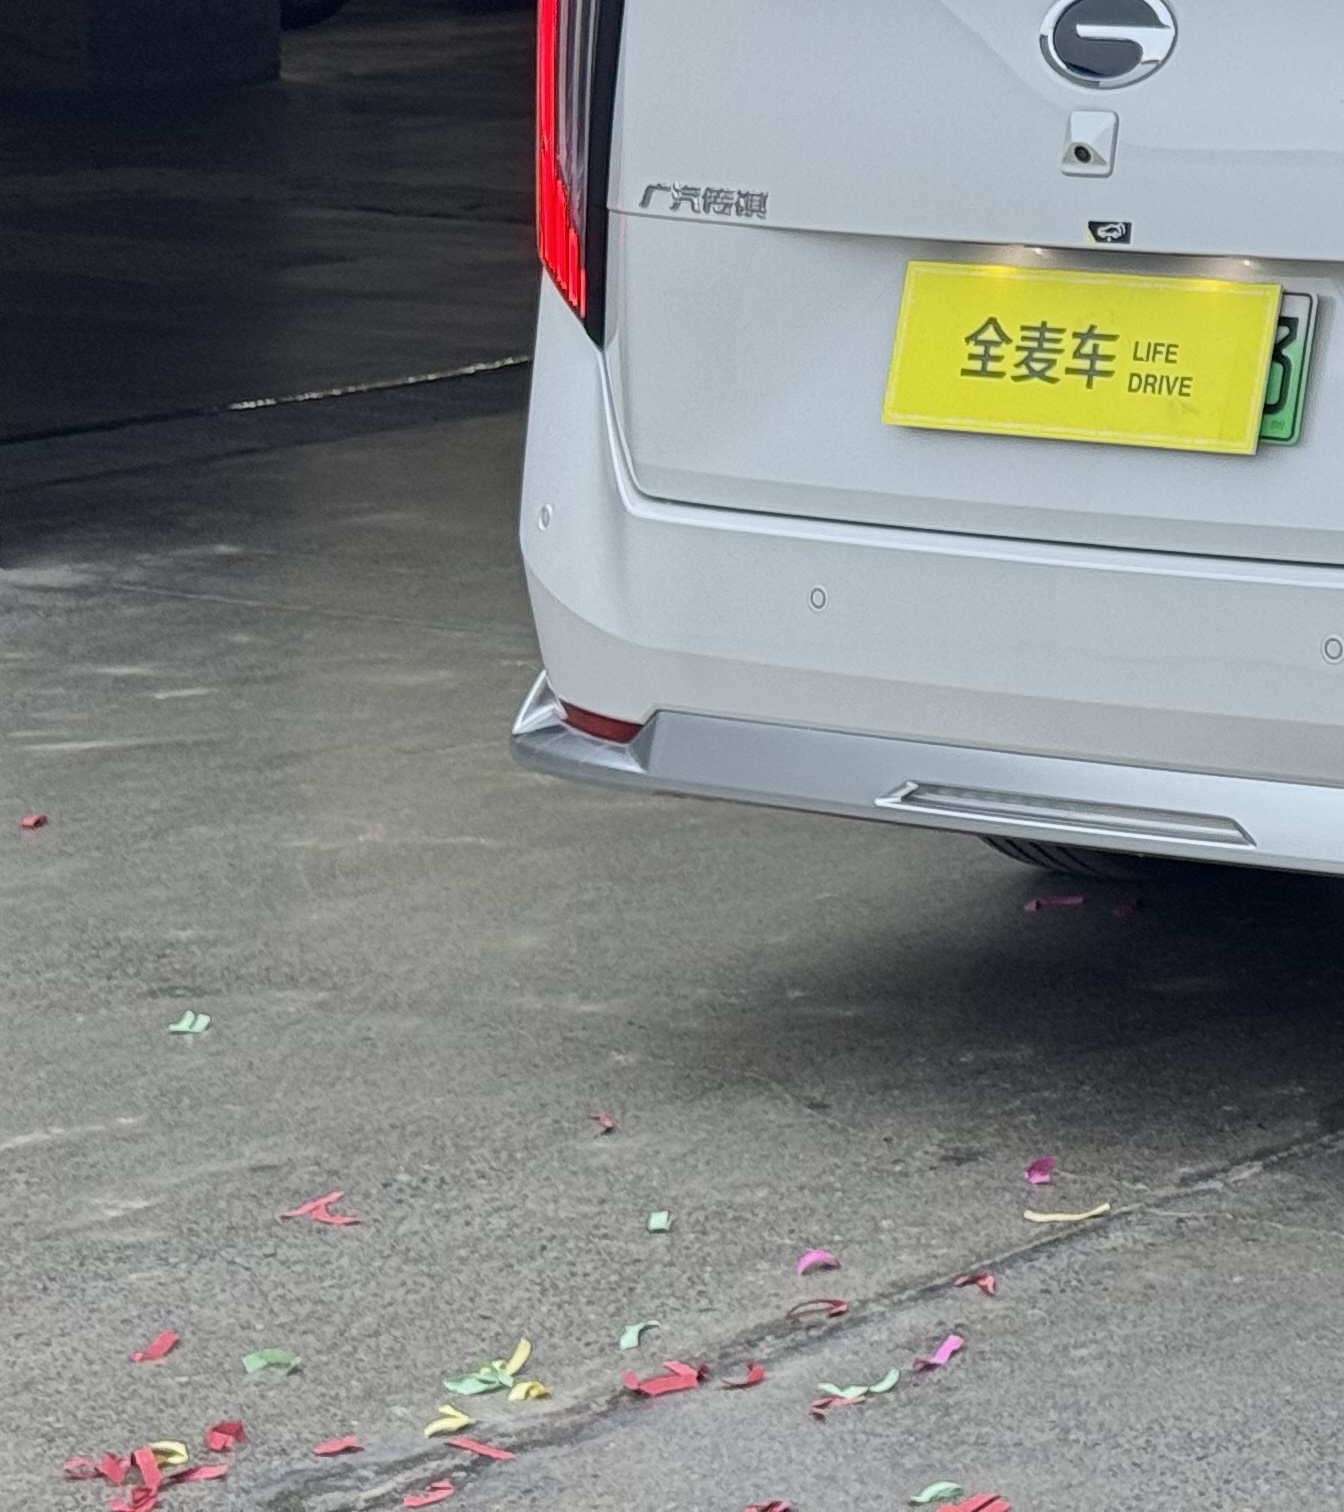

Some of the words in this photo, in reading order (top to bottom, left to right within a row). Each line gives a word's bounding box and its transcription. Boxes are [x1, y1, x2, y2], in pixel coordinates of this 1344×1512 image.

[960, 316, 1120, 390] 全麦车
[1132, 340, 1179, 365] LIFE
[1127, 372, 1194, 398] DRIVE
